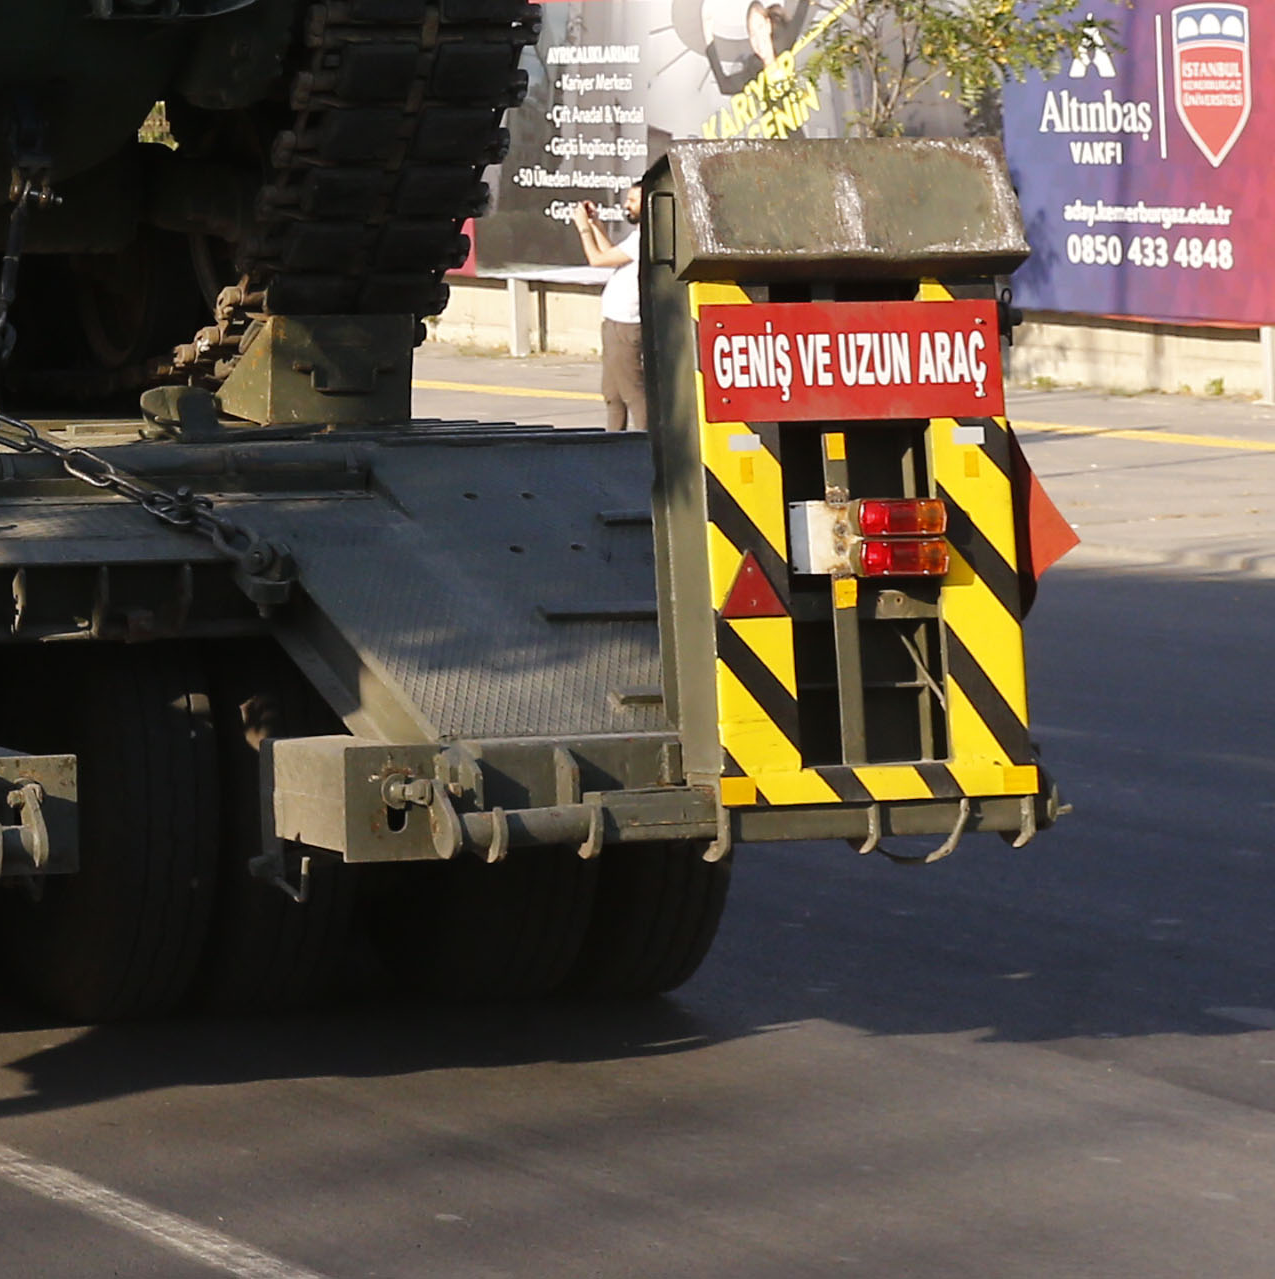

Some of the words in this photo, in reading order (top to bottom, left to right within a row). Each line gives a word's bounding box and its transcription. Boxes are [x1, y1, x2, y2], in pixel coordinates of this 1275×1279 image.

[561, 73, 594, 96] Kariyer
[595, 73, 633, 91] Merkezi
[552, 104, 571, 128] Çift
[572, 106, 603, 123] Anadal
[614, 106, 644, 123] Yandal
[1039, 89, 1152, 141] Altınbaş
[550, 136, 578, 160] Güçlü
[579, 134, 616, 160] İngilizce
[617, 137, 648, 161] Eğitim
[1069, 142, 1122, 164] VAKFI
[518, 168, 533, 187] 50
[534, 165, 571, 187] Ülkeden
[1064, 199, 1232, 229] aday.kemerburgaz.edu.tr
[1067, 234, 1123, 265] 0850
[1127, 236, 1169, 267] 433
[1173, 237, 1234, 270] 4848
[713, 321, 794, 402] GENİŞ
[796, 333, 835, 387] VE
[837, 332, 913, 387] UZUN
[918, 330, 987, 397] ARAÇ
